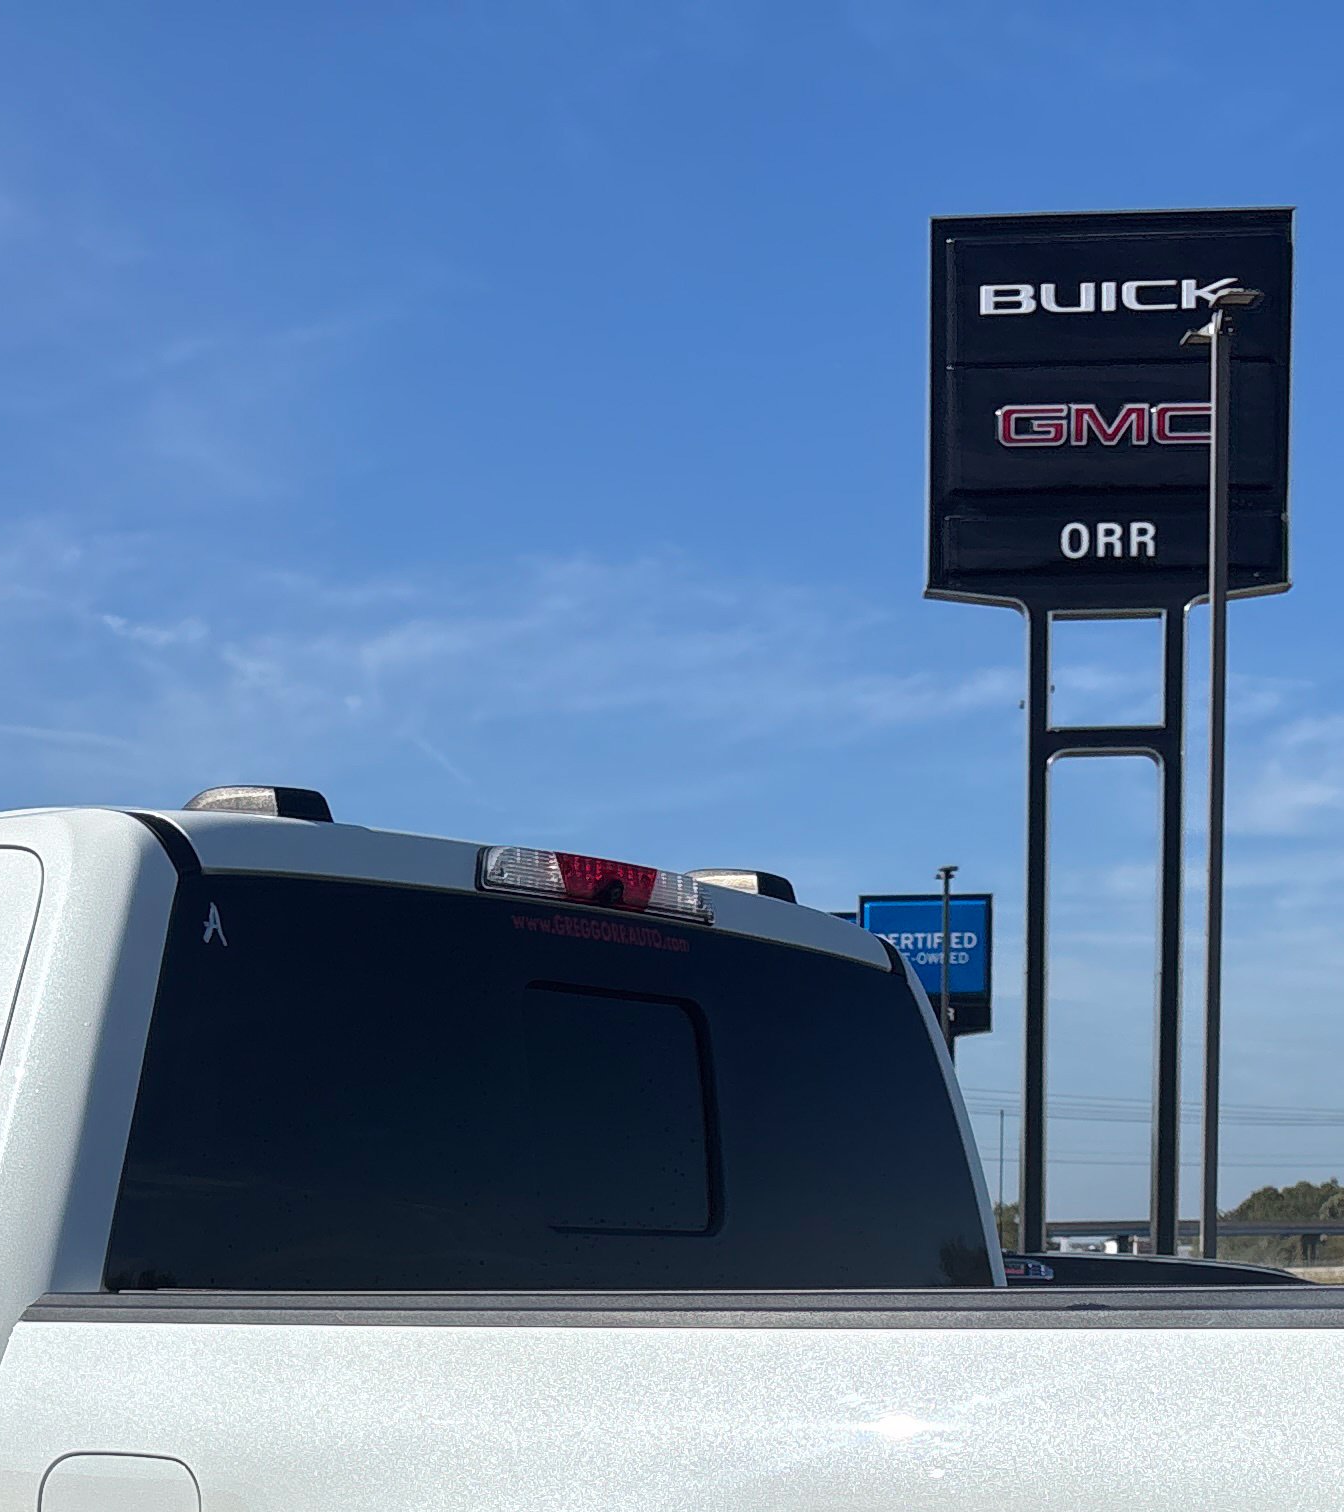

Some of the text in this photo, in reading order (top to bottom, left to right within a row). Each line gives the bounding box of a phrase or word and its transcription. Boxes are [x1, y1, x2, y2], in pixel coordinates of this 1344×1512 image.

[978, 277, 1239, 316] BUICK
[997, 402, 1213, 447] GMC
[1060, 520, 1156, 560] ORR
[882, 932, 978, 950] ERTIFED
